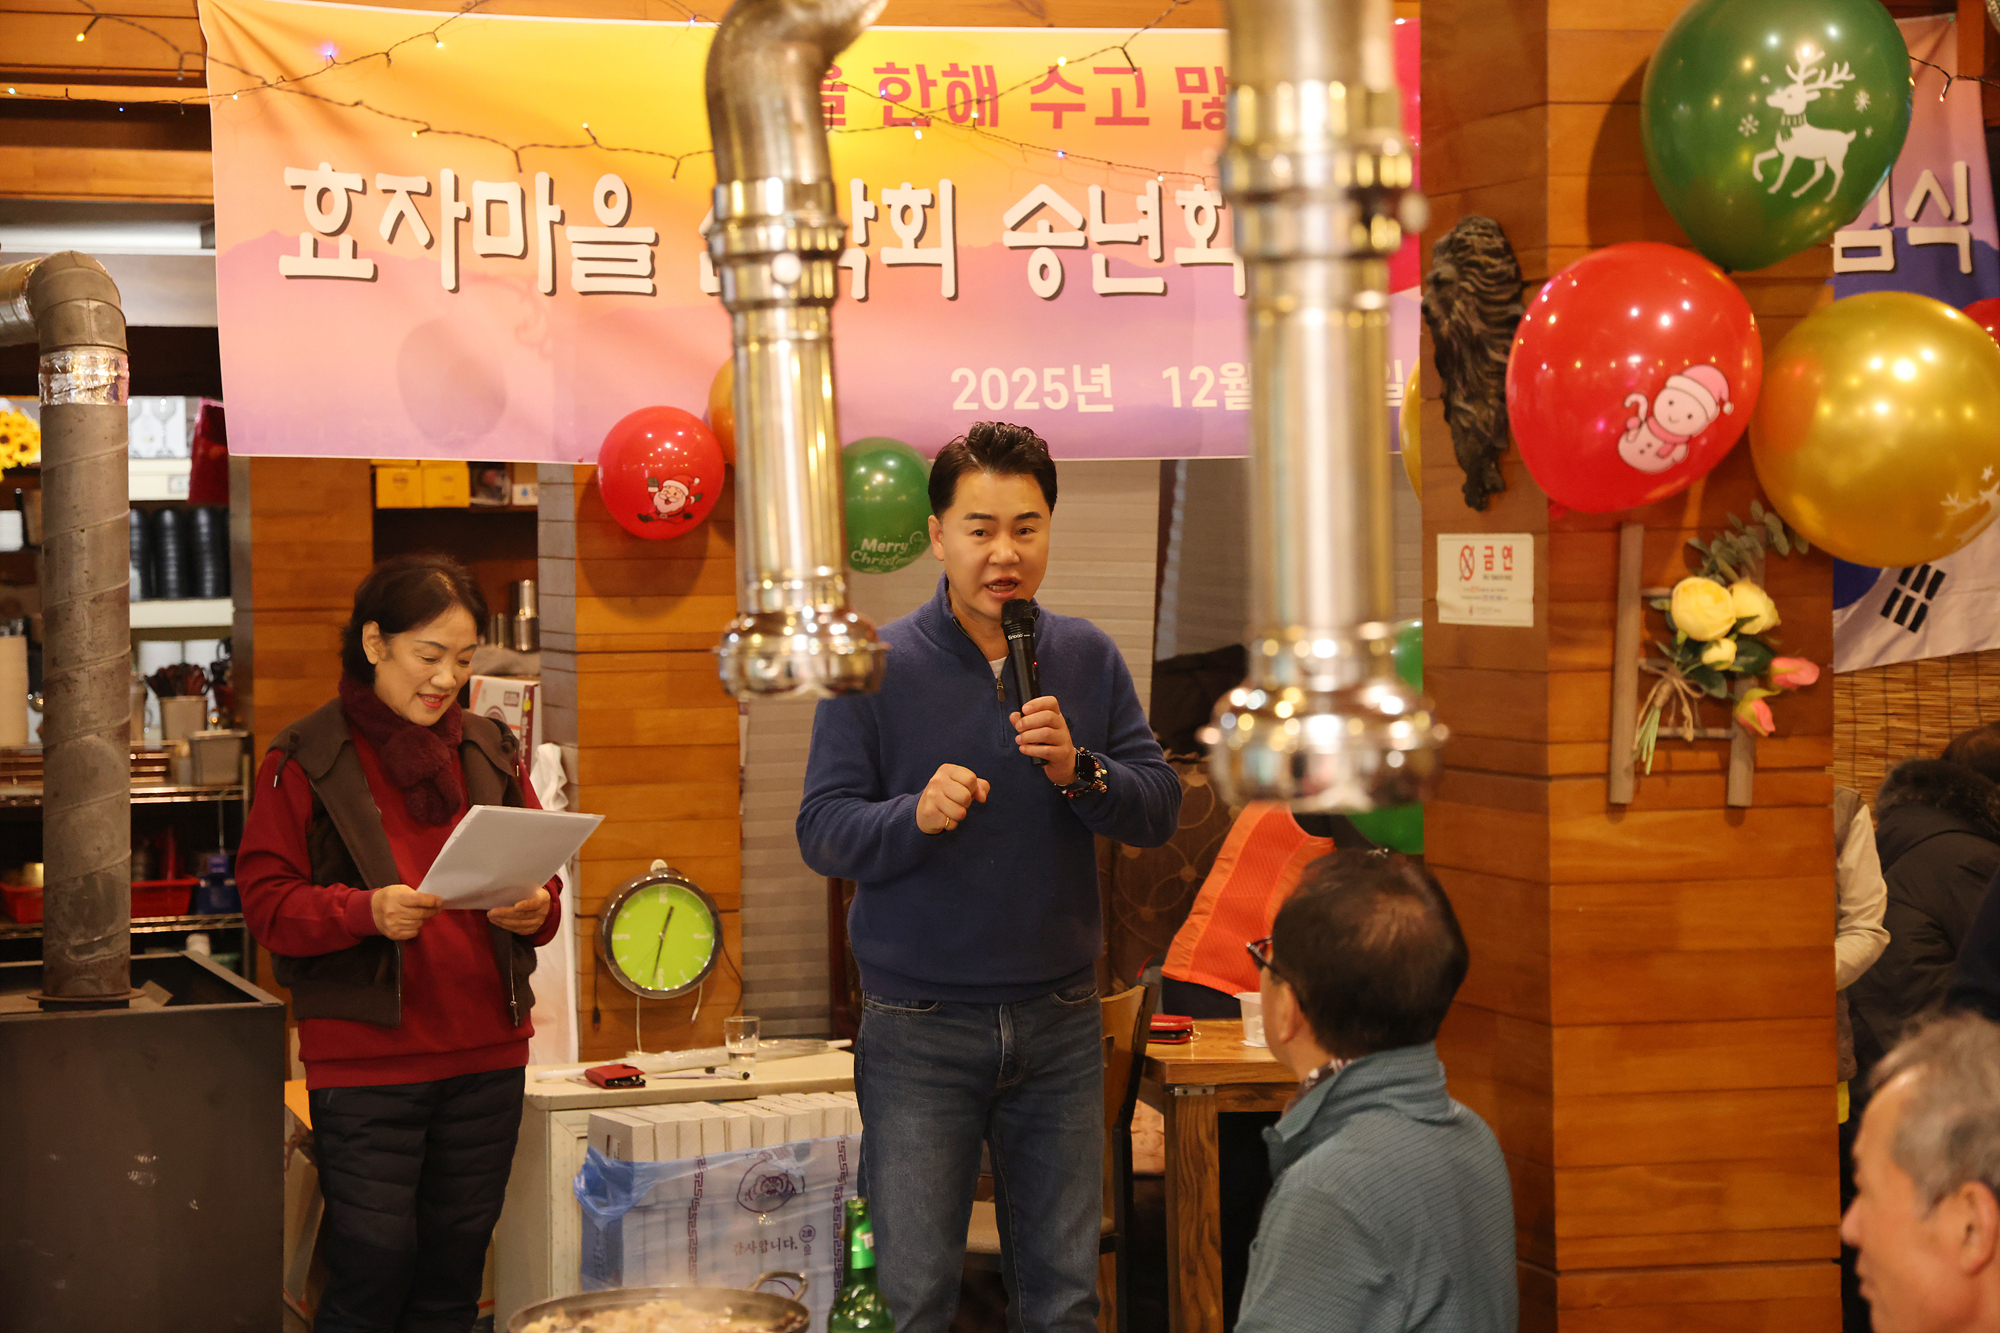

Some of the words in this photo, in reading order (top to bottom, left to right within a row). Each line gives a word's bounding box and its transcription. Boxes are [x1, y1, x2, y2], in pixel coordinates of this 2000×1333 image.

[873, 62, 999, 128] 한해
[1030, 65, 1150, 129] 수고
[278, 161, 657, 296] 효자마을
[1002, 179, 1248, 301] 송년회
[950, 363, 1114, 412] 2025년
[860, 538, 909, 554] Merry
